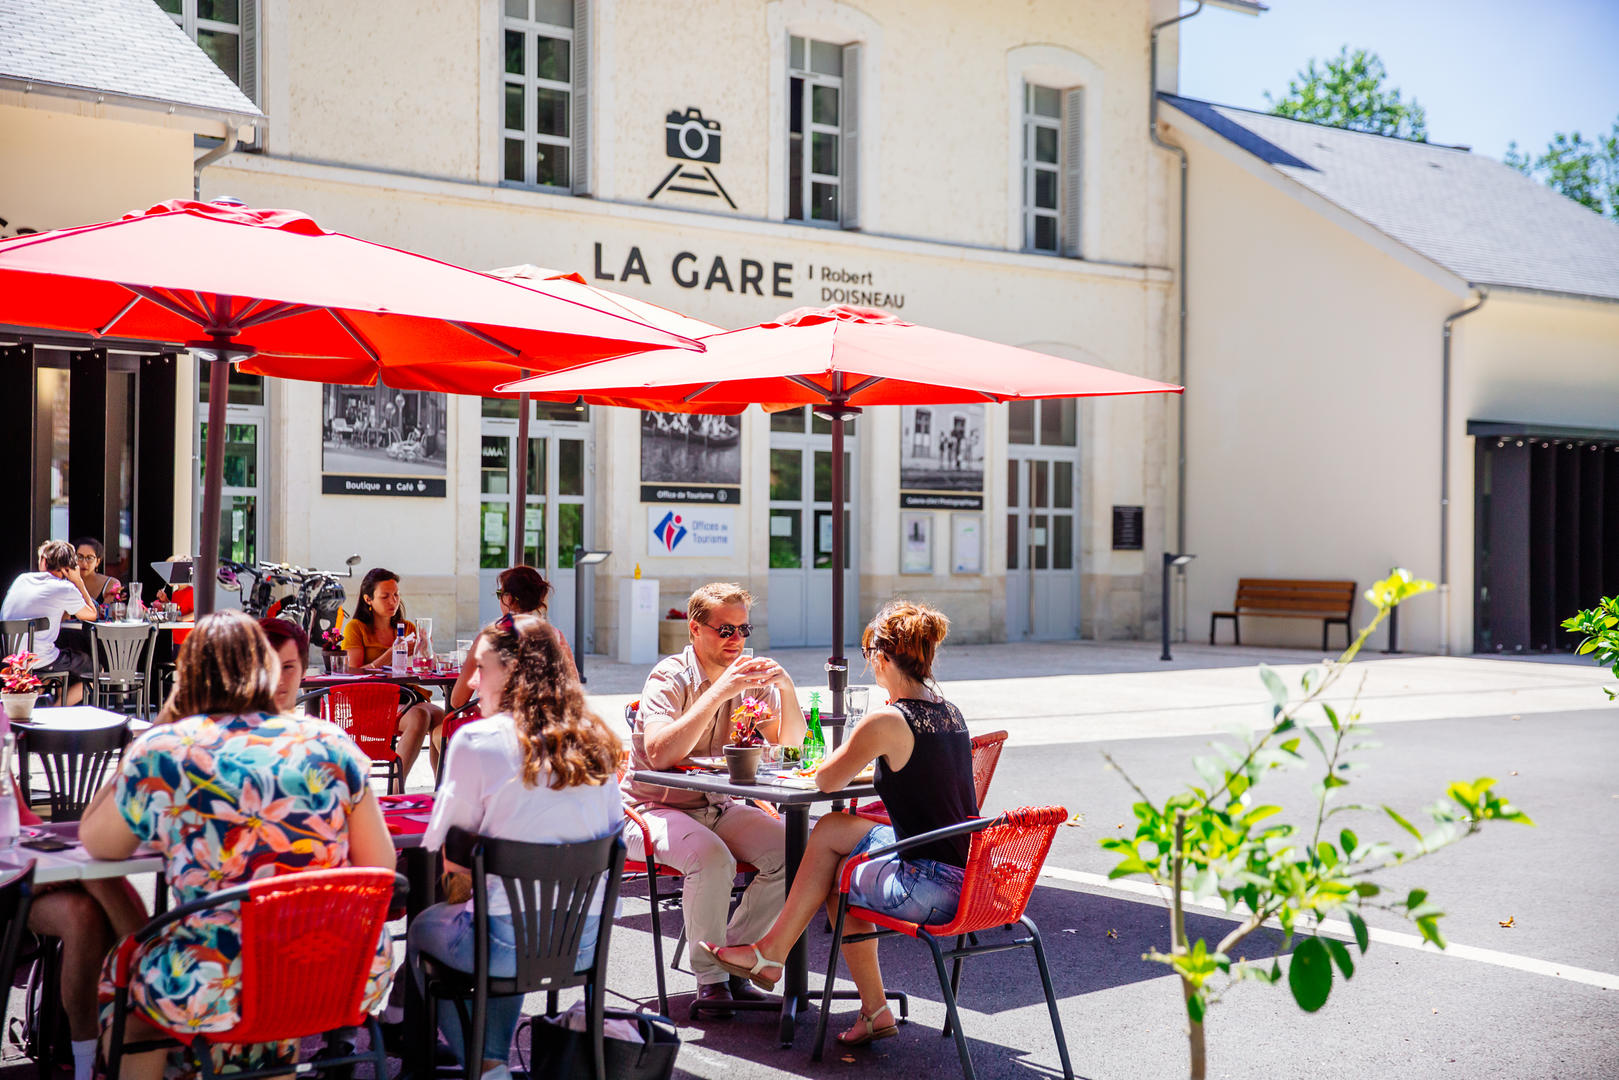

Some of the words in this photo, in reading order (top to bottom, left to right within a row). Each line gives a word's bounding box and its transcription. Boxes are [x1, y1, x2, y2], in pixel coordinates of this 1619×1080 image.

[594, 242, 651, 286] LA
[671, 251, 794, 298] GARE
[821, 266, 873, 287] Robert
[821, 287, 905, 309] DOISNEAU
[345, 481, 381, 492] Boutique
[656, 490, 676, 499] Office
[677, 491, 686, 499] de
[687, 491, 715, 500] Tourisme
[692, 520, 719, 531] Offices
[693, 532, 728, 544] Tourisme
